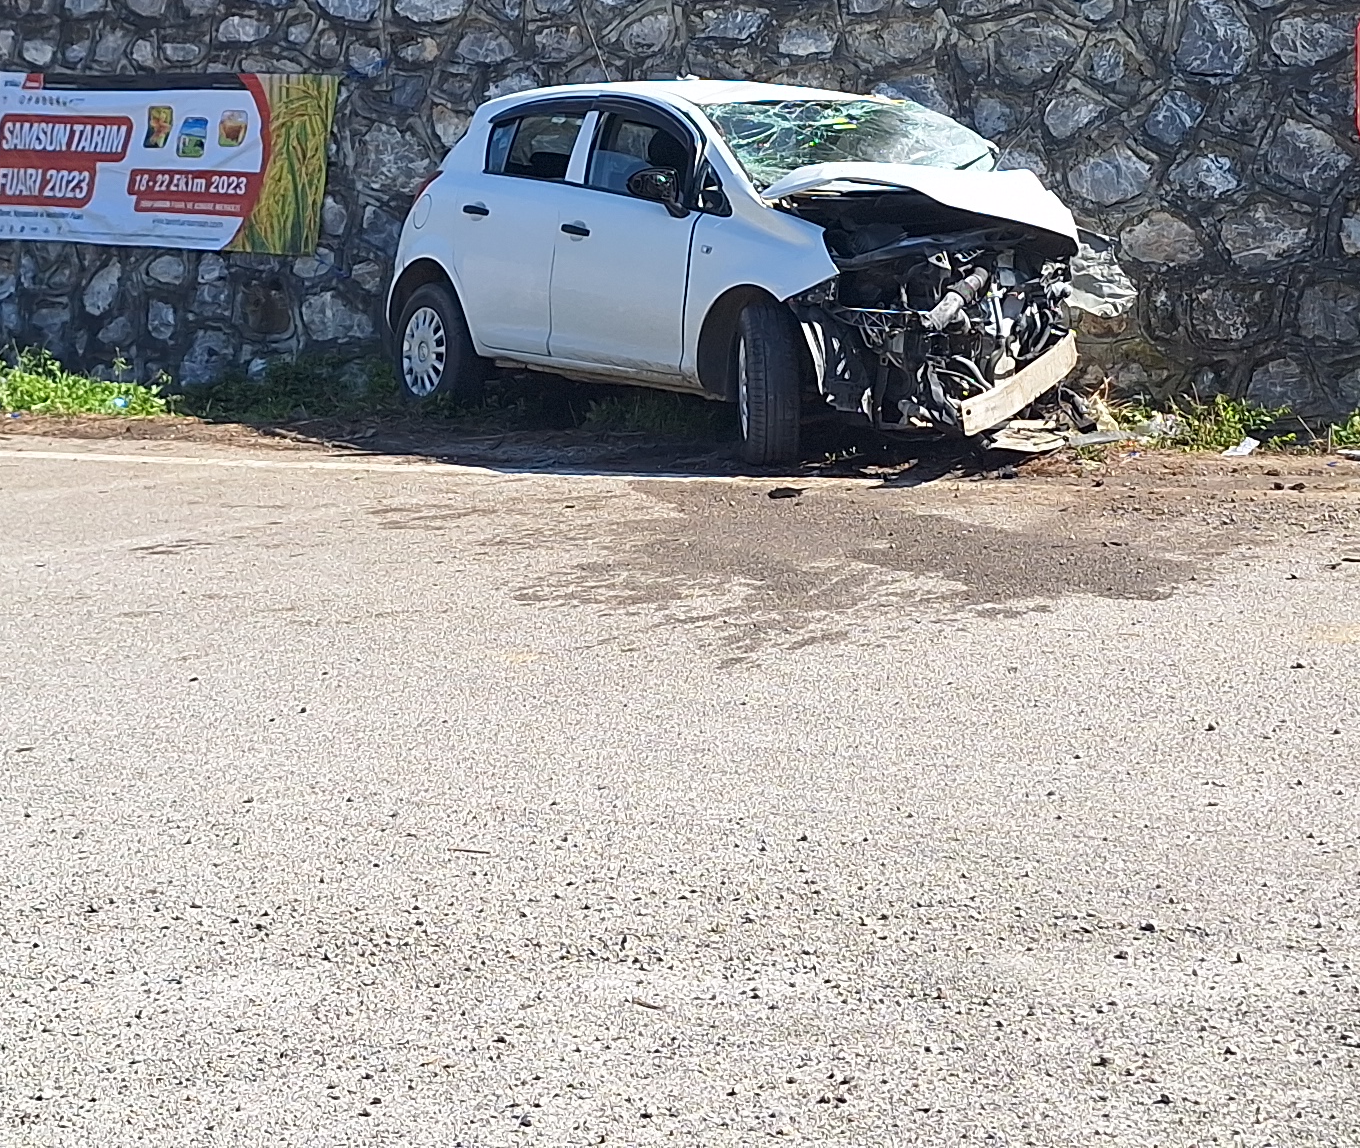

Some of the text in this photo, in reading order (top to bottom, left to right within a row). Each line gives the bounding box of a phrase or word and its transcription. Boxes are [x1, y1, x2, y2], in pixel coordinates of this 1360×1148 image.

[2, 121, 128, 153] SAMSUN TARIM
[42, 169, 91, 199] 2023
[170, 173, 207, 193] Ekim
[208, 175, 248, 195] 2023
